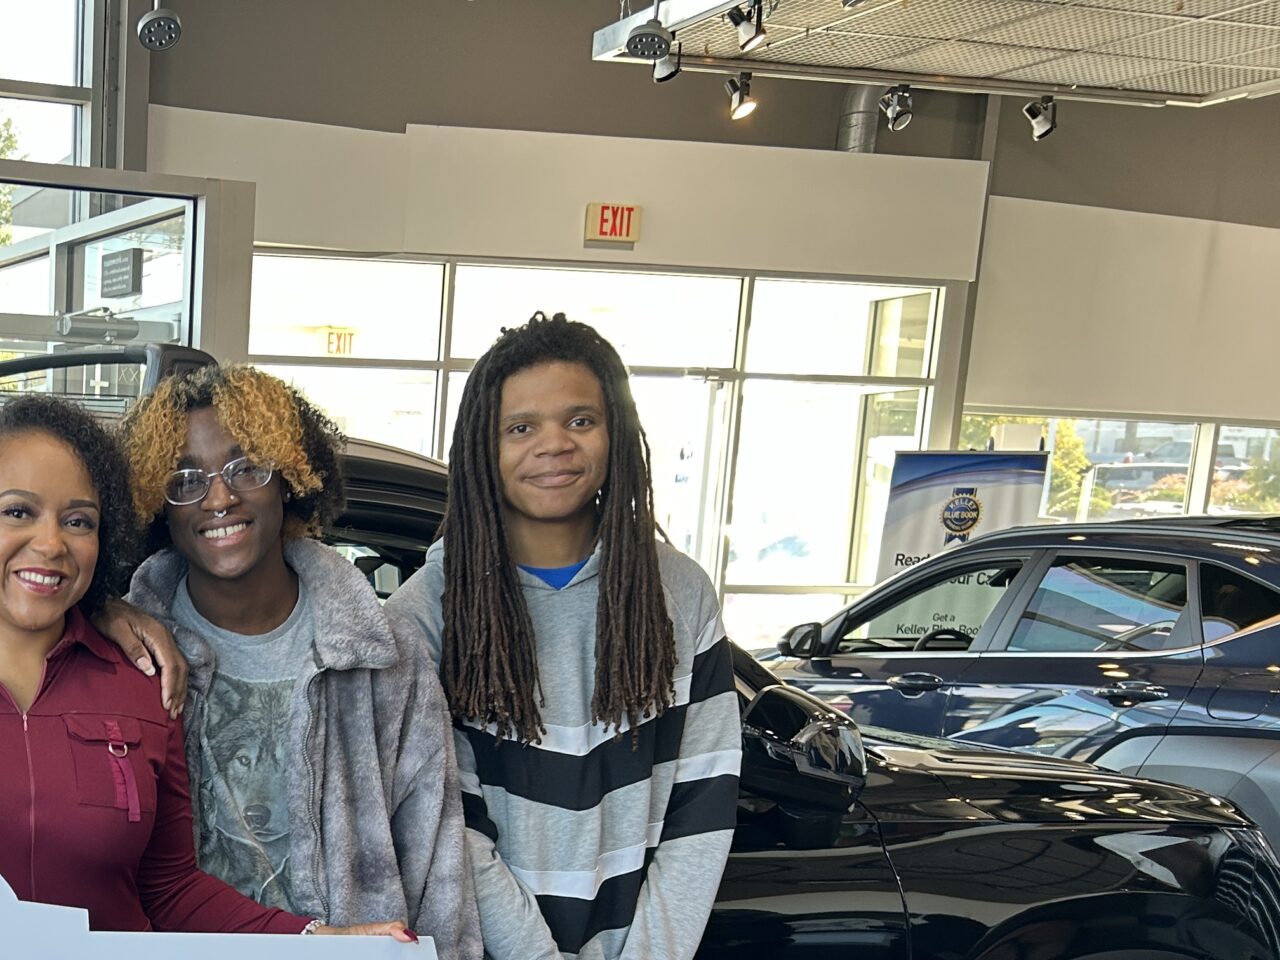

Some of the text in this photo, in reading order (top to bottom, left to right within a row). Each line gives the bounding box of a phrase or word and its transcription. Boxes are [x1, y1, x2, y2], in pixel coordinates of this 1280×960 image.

[599, 205, 635, 237] EXIT
[327, 332, 354, 354] EXIT
[895, 553, 930, 566] Read
[949, 572, 991, 585] our Ca
[932, 613, 947, 622] Get
[896, 624, 930, 635] Kelley
